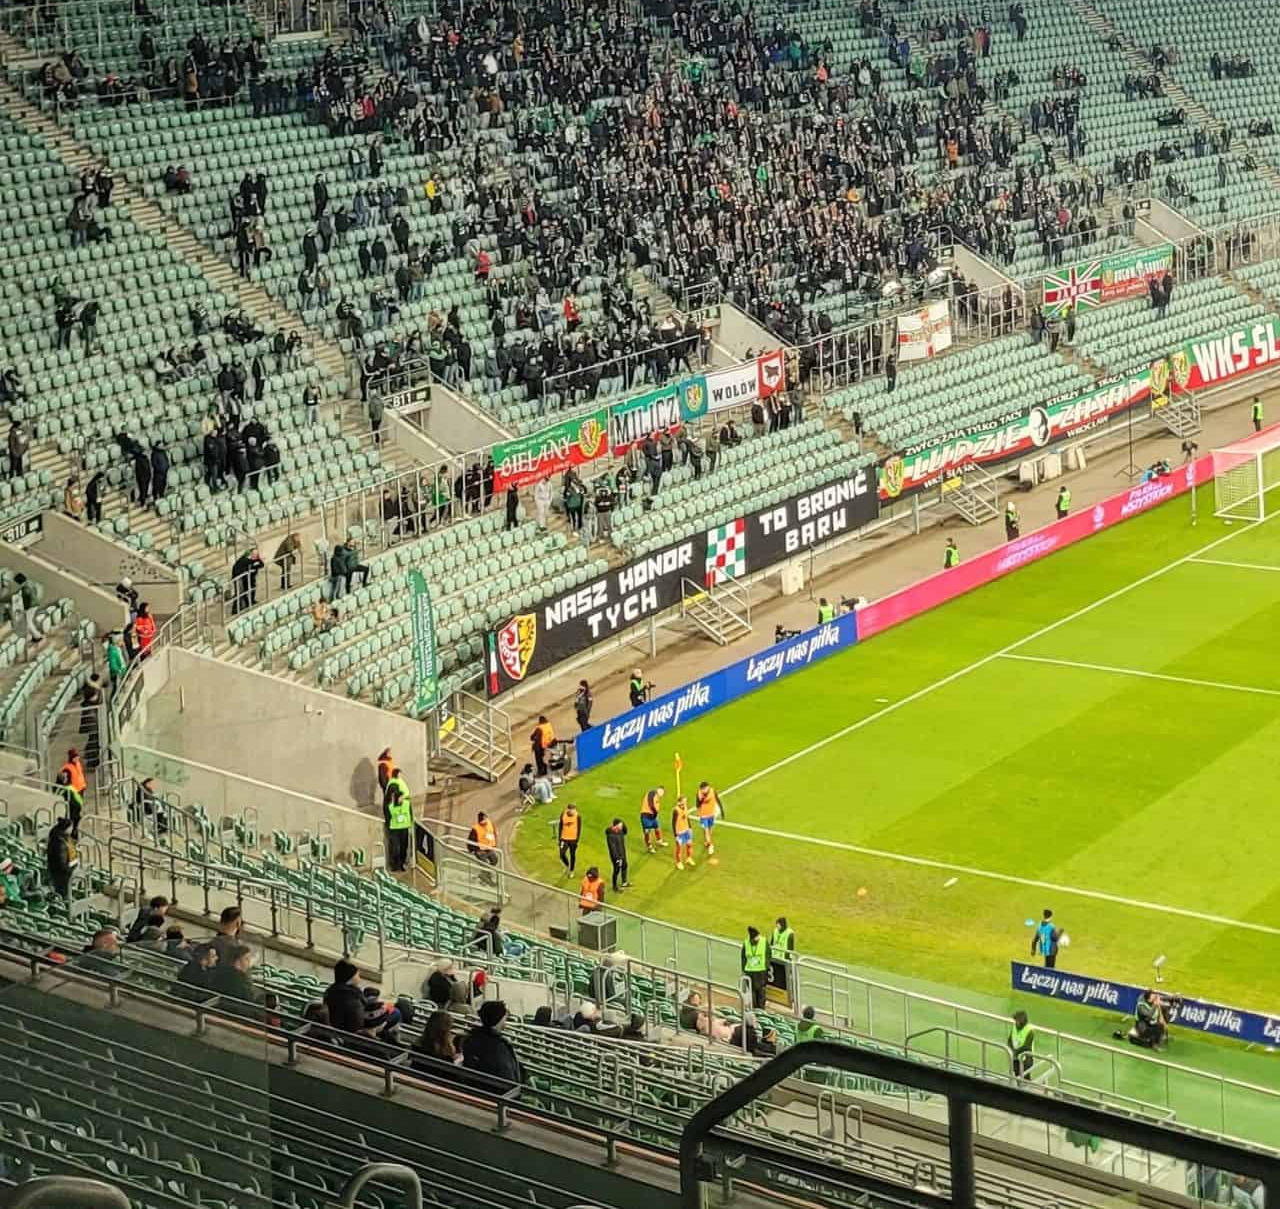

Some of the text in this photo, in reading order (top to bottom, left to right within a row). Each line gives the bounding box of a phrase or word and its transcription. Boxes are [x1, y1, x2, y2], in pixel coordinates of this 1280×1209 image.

[1191, 331, 1249, 383] WKS
[393, 392, 412, 407] B11
[613, 395, 681, 446] MILICZ
[965, 420, 998, 436] TYLKO
[500, 433, 572, 477] BIELANY
[758, 469, 868, 536] TO BRONIĆ
[785, 507, 847, 553] BARW
[545, 541, 693, 631] NASZ HONOR
[587, 586, 658, 639] TYCH
[746, 623, 840, 683] Łączy nas piłka
[602, 681, 711, 750] Łączy nas piłka
[1021, 967, 1119, 1005] Łączy nas piłka
[1180, 1003, 1206, 1024] nas
[1204, 1007, 1243, 1033] piłka
